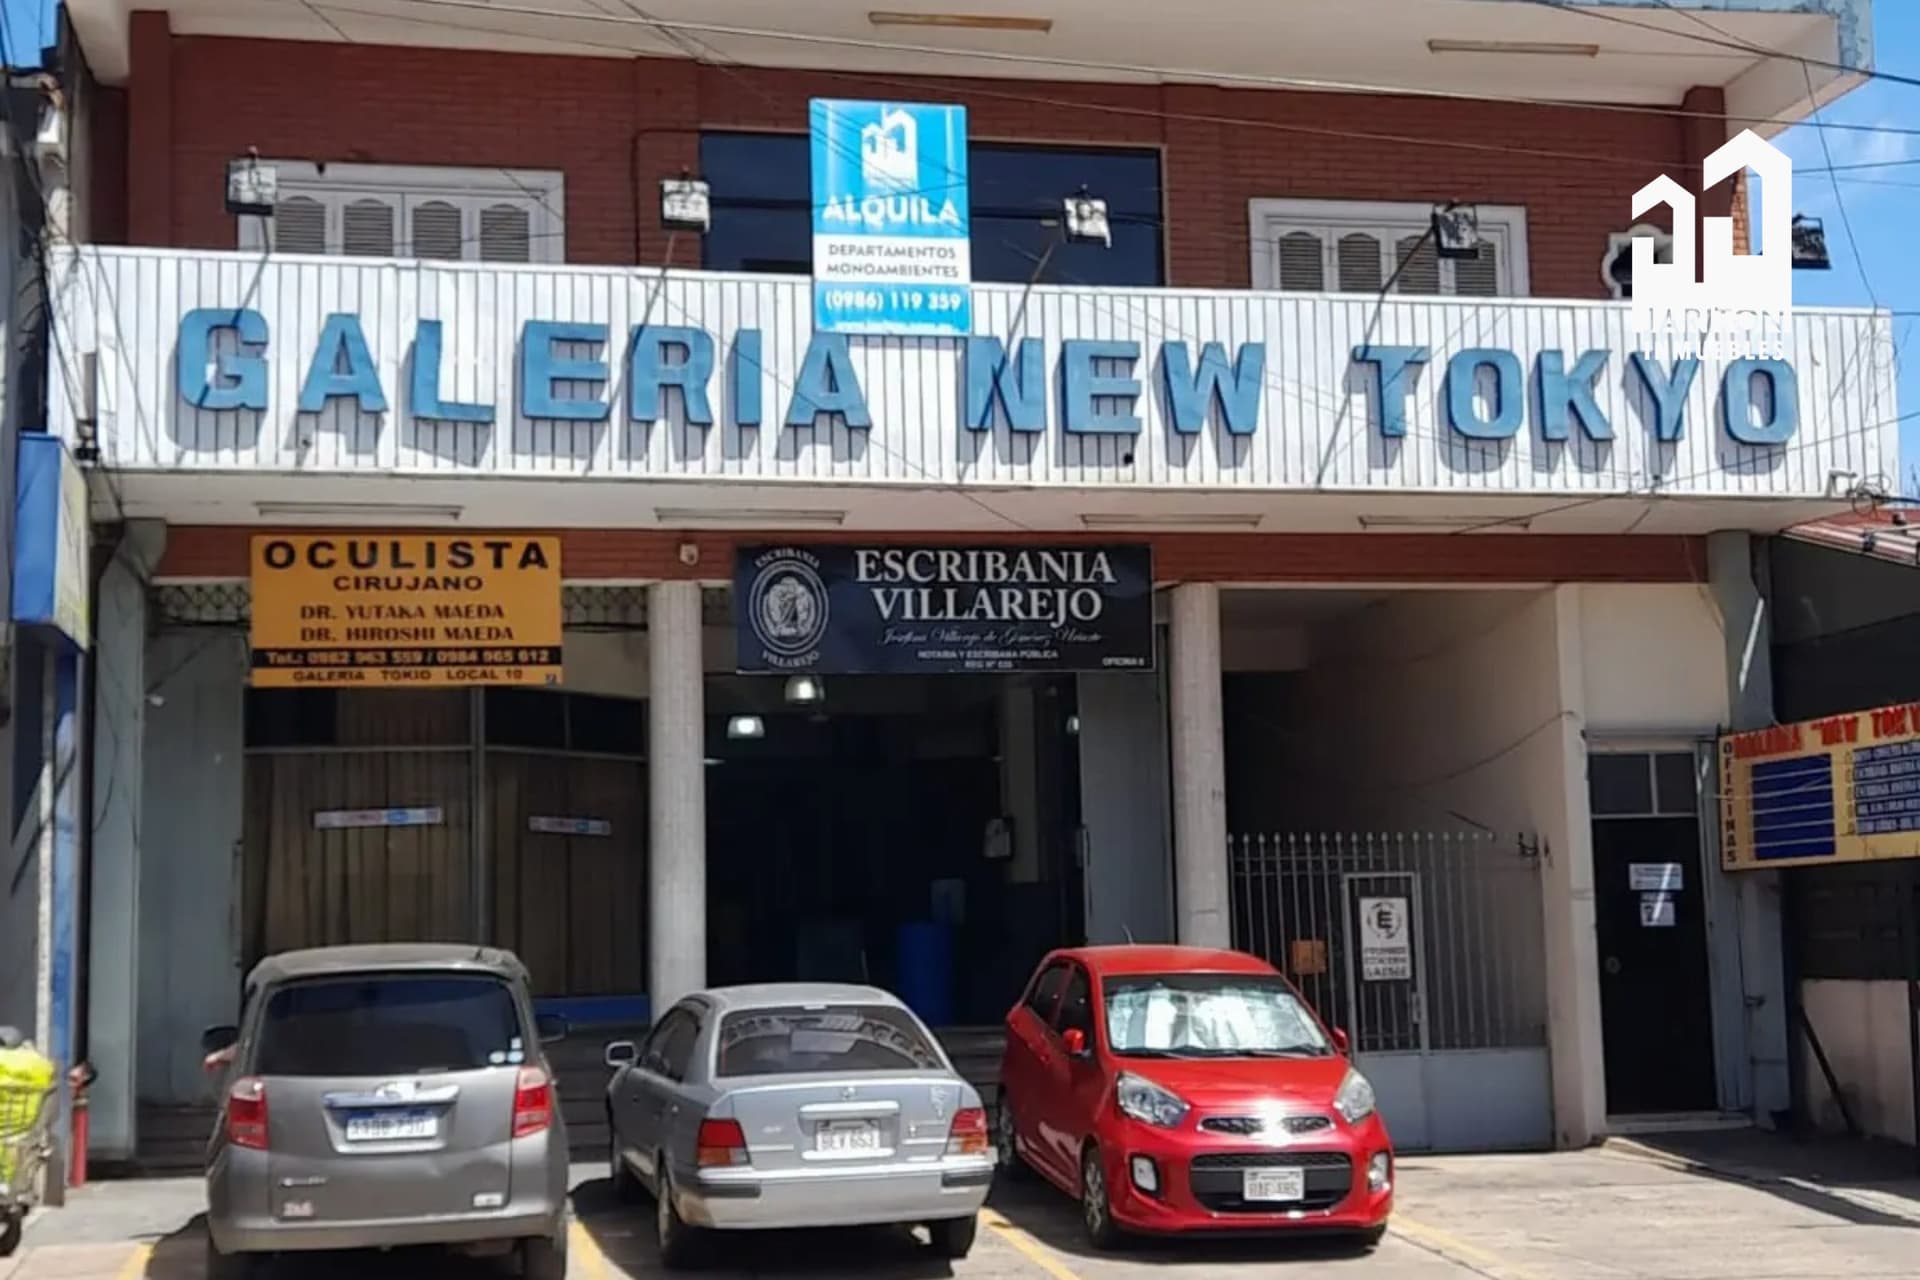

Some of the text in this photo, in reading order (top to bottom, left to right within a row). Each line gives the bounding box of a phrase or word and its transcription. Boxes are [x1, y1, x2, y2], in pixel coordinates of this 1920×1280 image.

[823, 195, 960, 228] ALQUILA
[828, 243, 956, 258] DEPARTAMENTOS
[826, 262, 959, 278] MONOAMBIENTES
[890, 291, 922, 309] 119
[177, 306, 1799, 446] GALERIA NEW TOKYO
[263, 540, 549, 570] OCULISTA
[855, 549, 1116, 584] ESCRIBANIA
[333, 575, 484, 592] CIRUJANO
[300, 604, 505, 620] DR. YUTAKA MAEDA
[871, 588, 1103, 628] VILLAREJO
[300, 625, 514, 642] DR. HIROSHI MAEDA
[293, 669, 365, 682] GALERIA
[380, 669, 432, 681] TOKIO
[446, 669, 498, 680] LOCAL
